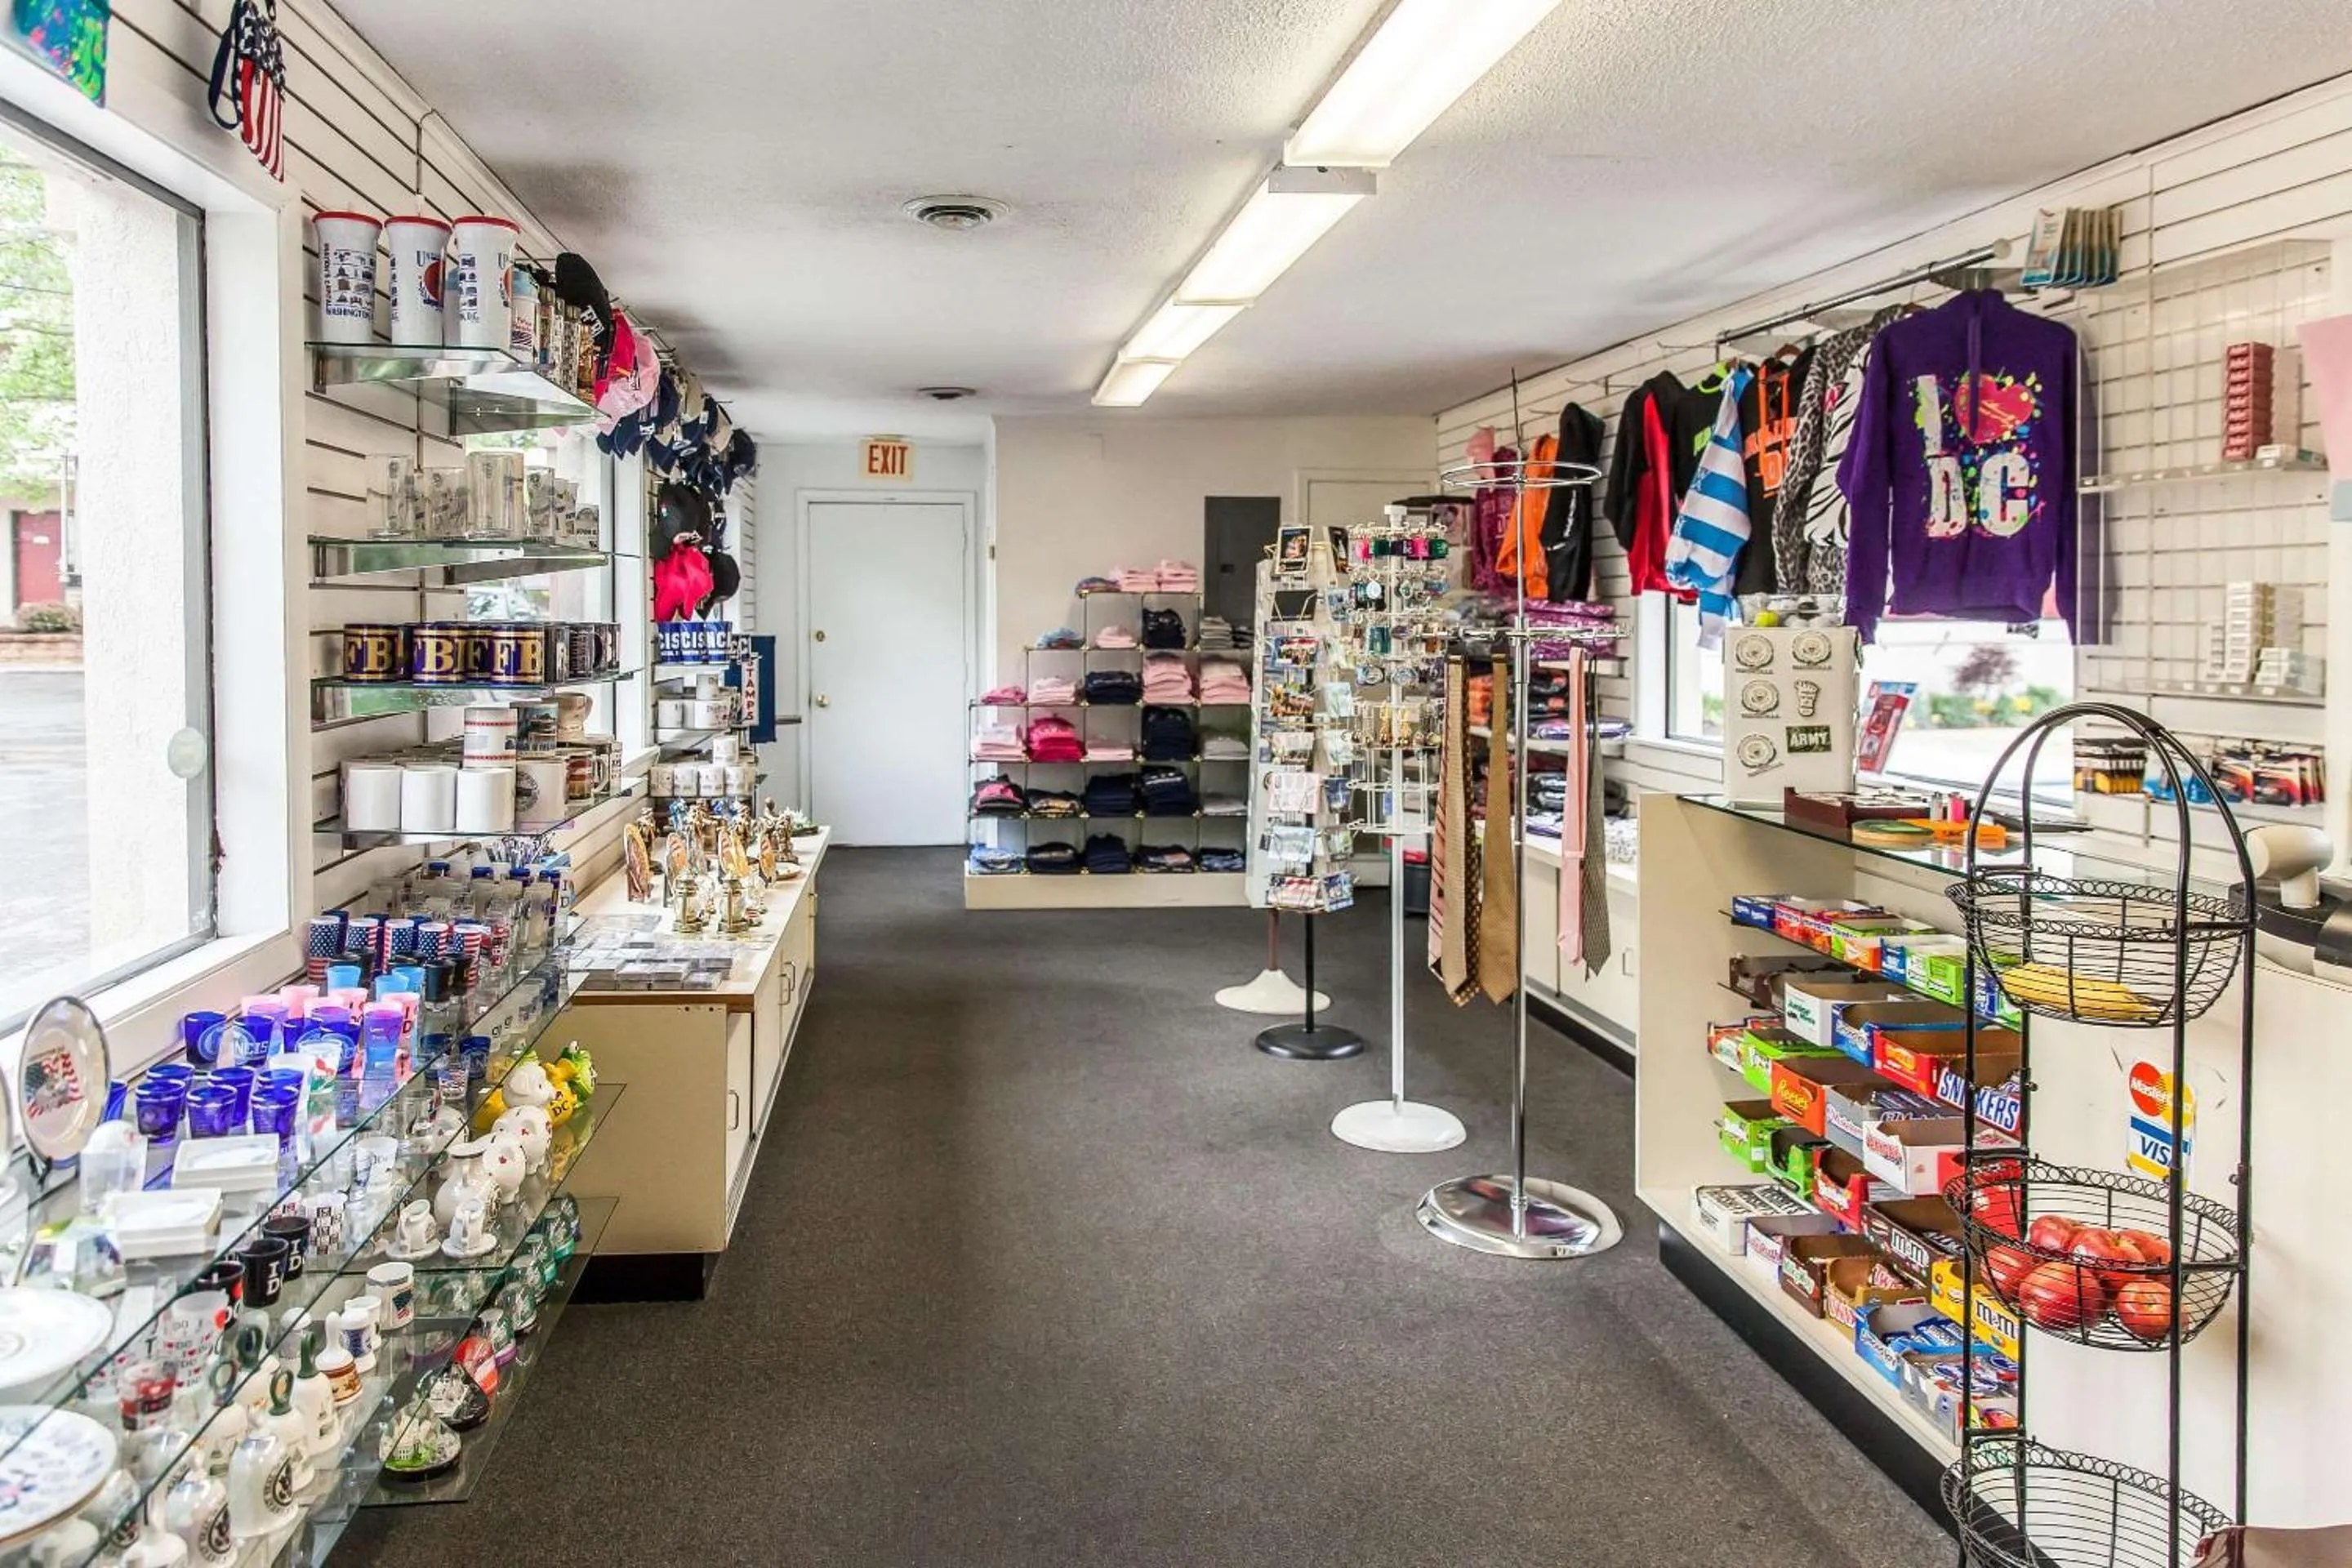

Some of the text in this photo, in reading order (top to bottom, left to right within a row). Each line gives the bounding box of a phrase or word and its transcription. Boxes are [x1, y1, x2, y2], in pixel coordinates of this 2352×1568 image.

[869, 444, 908, 474] EXIT
[1926, 452, 2031, 537] DC
[1789, 733, 1829, 747] ARMY
[234, 1040, 269, 1054] NCIS
[1940, 1071, 2019, 1130] SNIKERS
[2140, 1136, 2172, 1168] VIS
